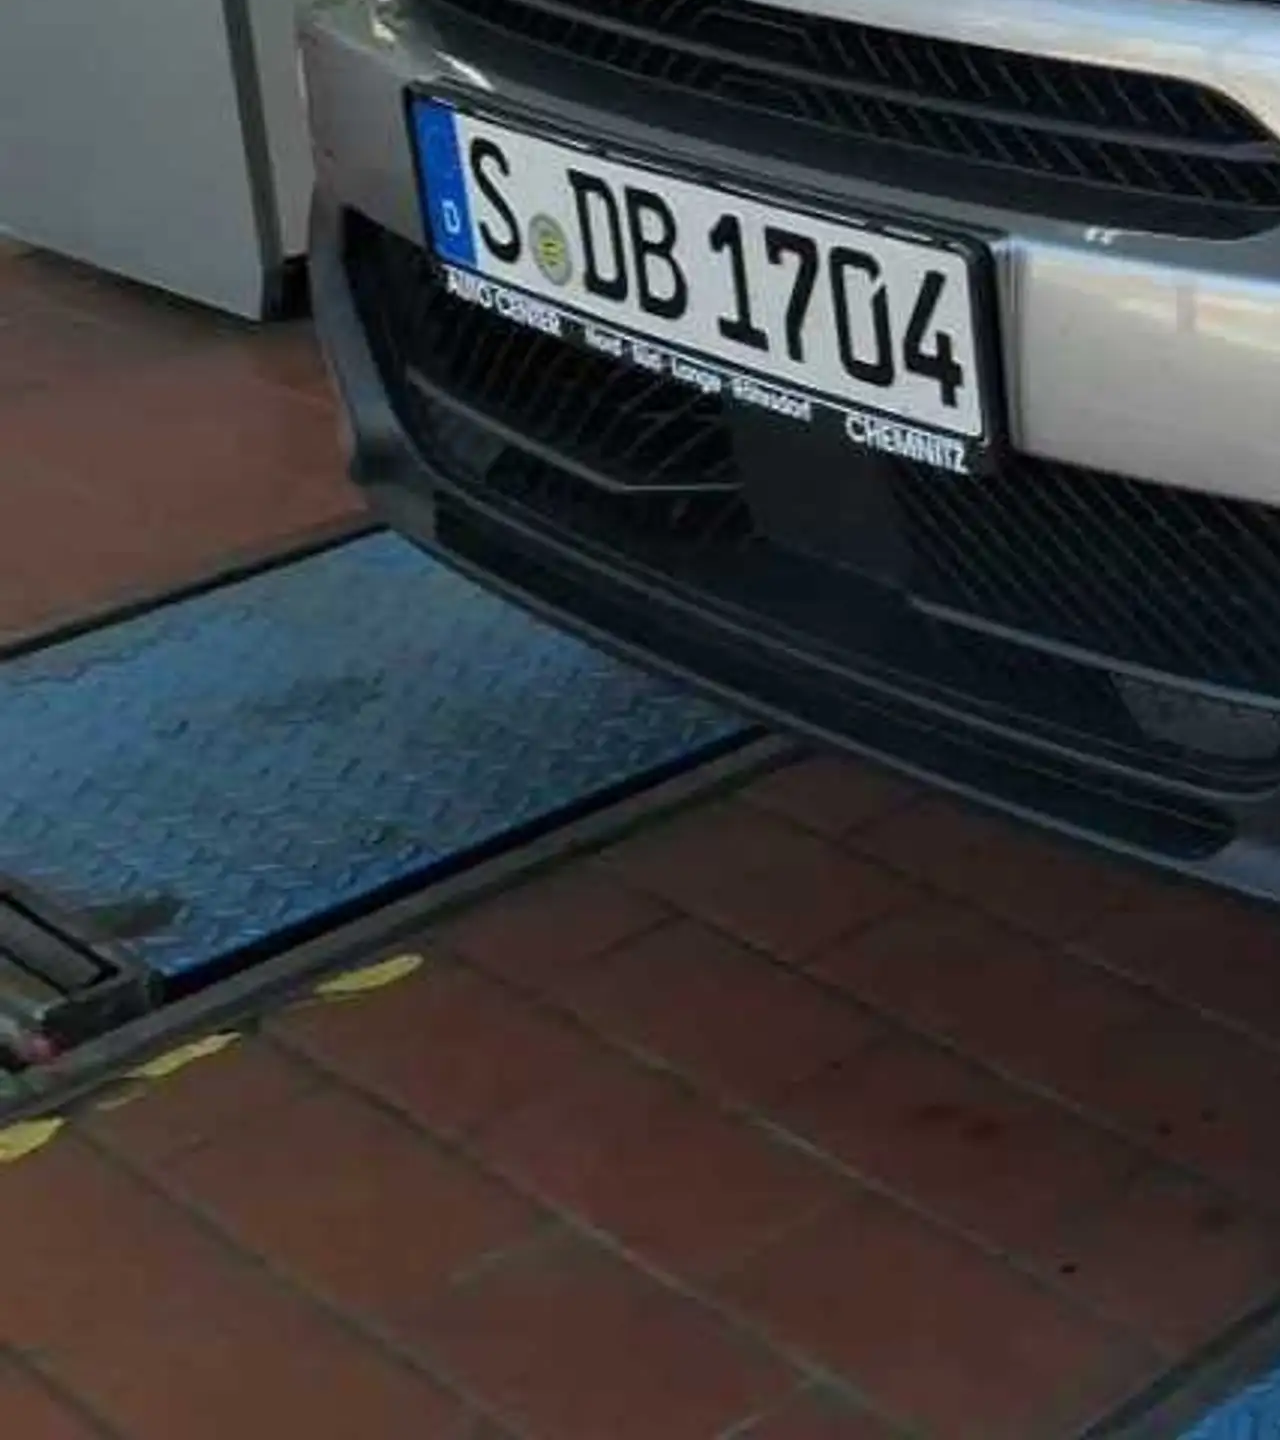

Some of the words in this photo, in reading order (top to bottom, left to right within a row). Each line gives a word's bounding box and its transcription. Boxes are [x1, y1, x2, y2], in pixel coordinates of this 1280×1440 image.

[441, 199, 461, 235] D
[470, 136, 521, 264] S
[567, 167, 687, 320] DB
[708, 213, 965, 409] 1704
